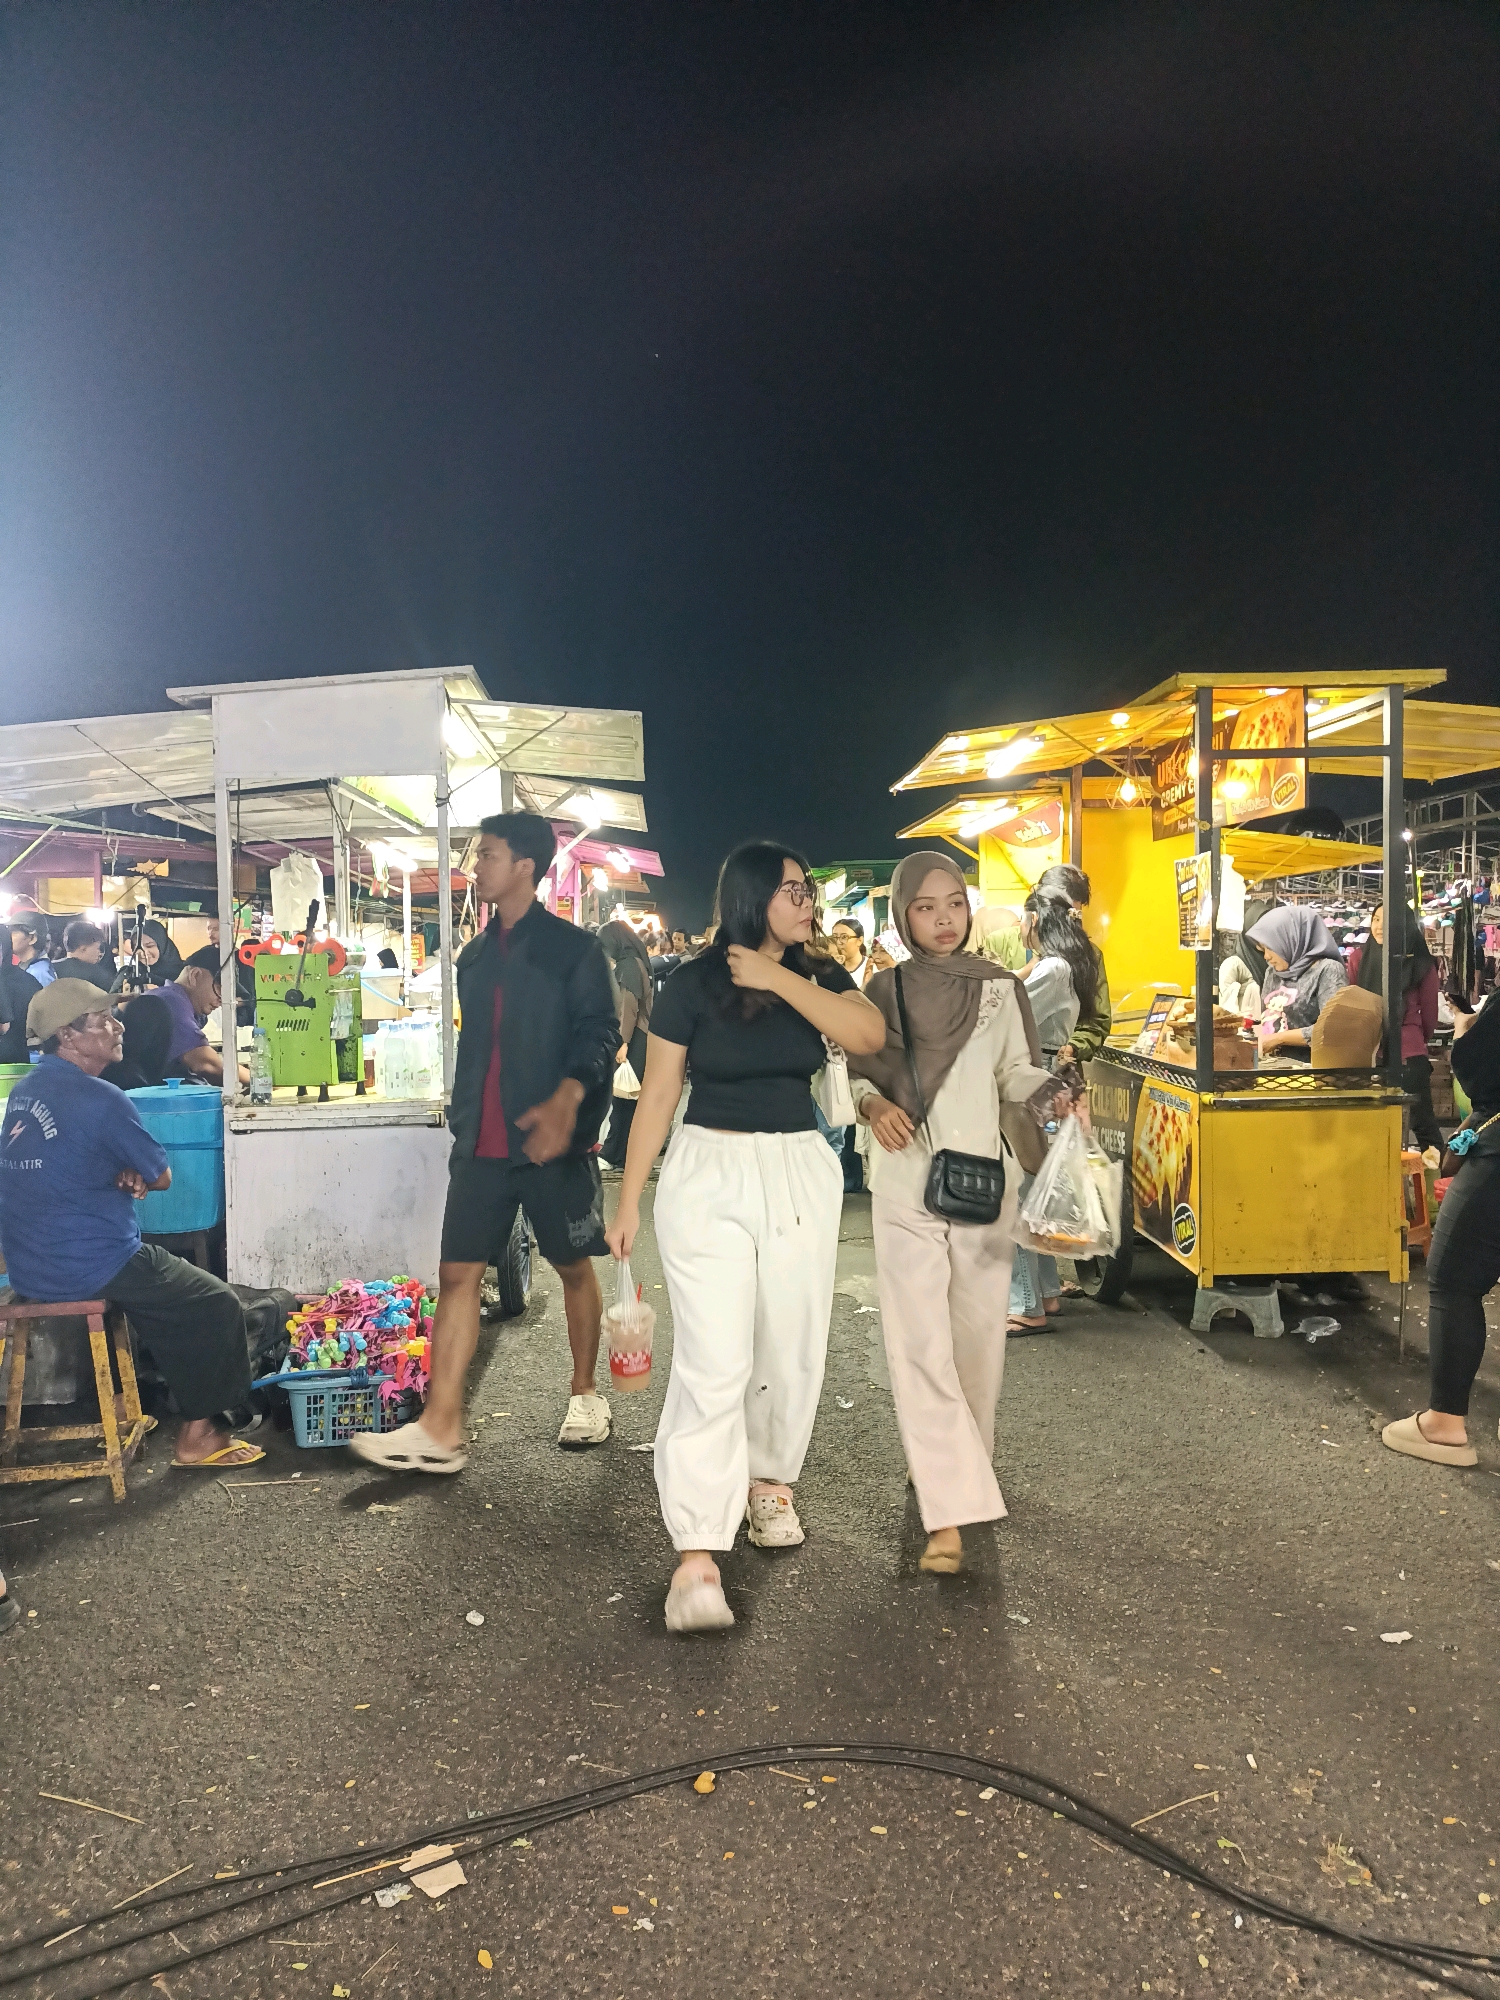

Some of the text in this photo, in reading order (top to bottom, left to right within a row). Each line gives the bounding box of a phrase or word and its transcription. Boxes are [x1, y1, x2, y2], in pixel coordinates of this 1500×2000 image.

[1160, 781, 1187, 808] CREMY
[1275, 778, 1296, 802] VIRAL
[30, 1099, 58, 1140] AGUNG
[1100, 1127, 1126, 1155] CHEESE
[1175, 1218, 1194, 1242] VIRAL
